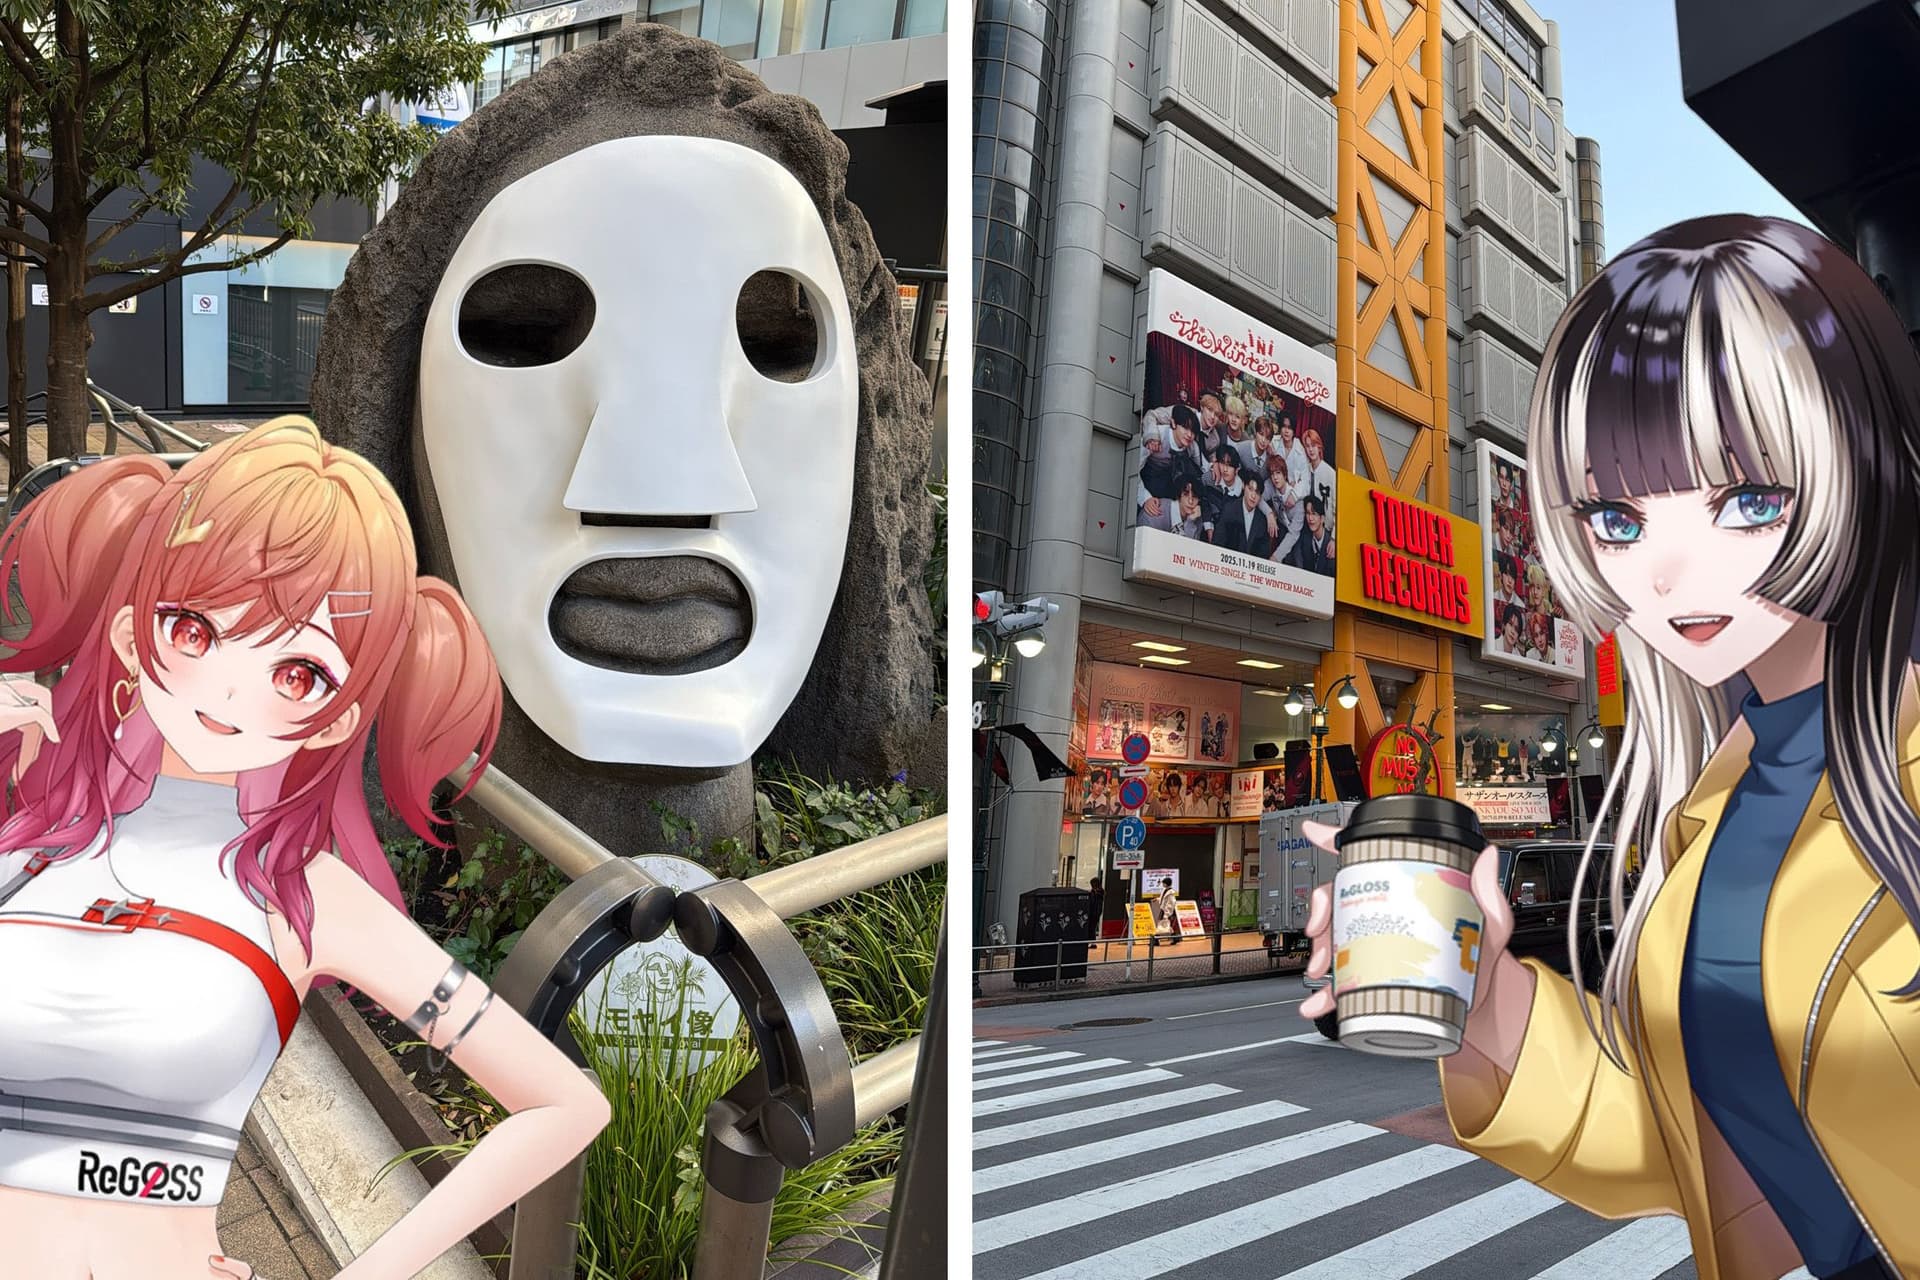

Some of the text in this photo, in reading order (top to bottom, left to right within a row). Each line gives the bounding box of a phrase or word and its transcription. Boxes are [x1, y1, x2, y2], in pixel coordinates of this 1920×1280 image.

[1369, 489, 1455, 567] TOWER
[1172, 553, 1186, 566] INI
[1188, 558, 1220, 574] WINTER
[1220, 566, 1246, 581] SINGLE
[1249, 574, 1264, 585] THE
[1264, 577, 1293, 592] WINTER
[1292, 584, 1315, 598] MAGIC
[1220, 553, 1277, 576] 2025.11.19 RELEASE
[1360, 543, 1472, 625] RECORDS
[1396, 736, 1418, 754] NO
[1121, 825, 1134, 846] P
[606, 1008, 713, 1036] モヤイ像
